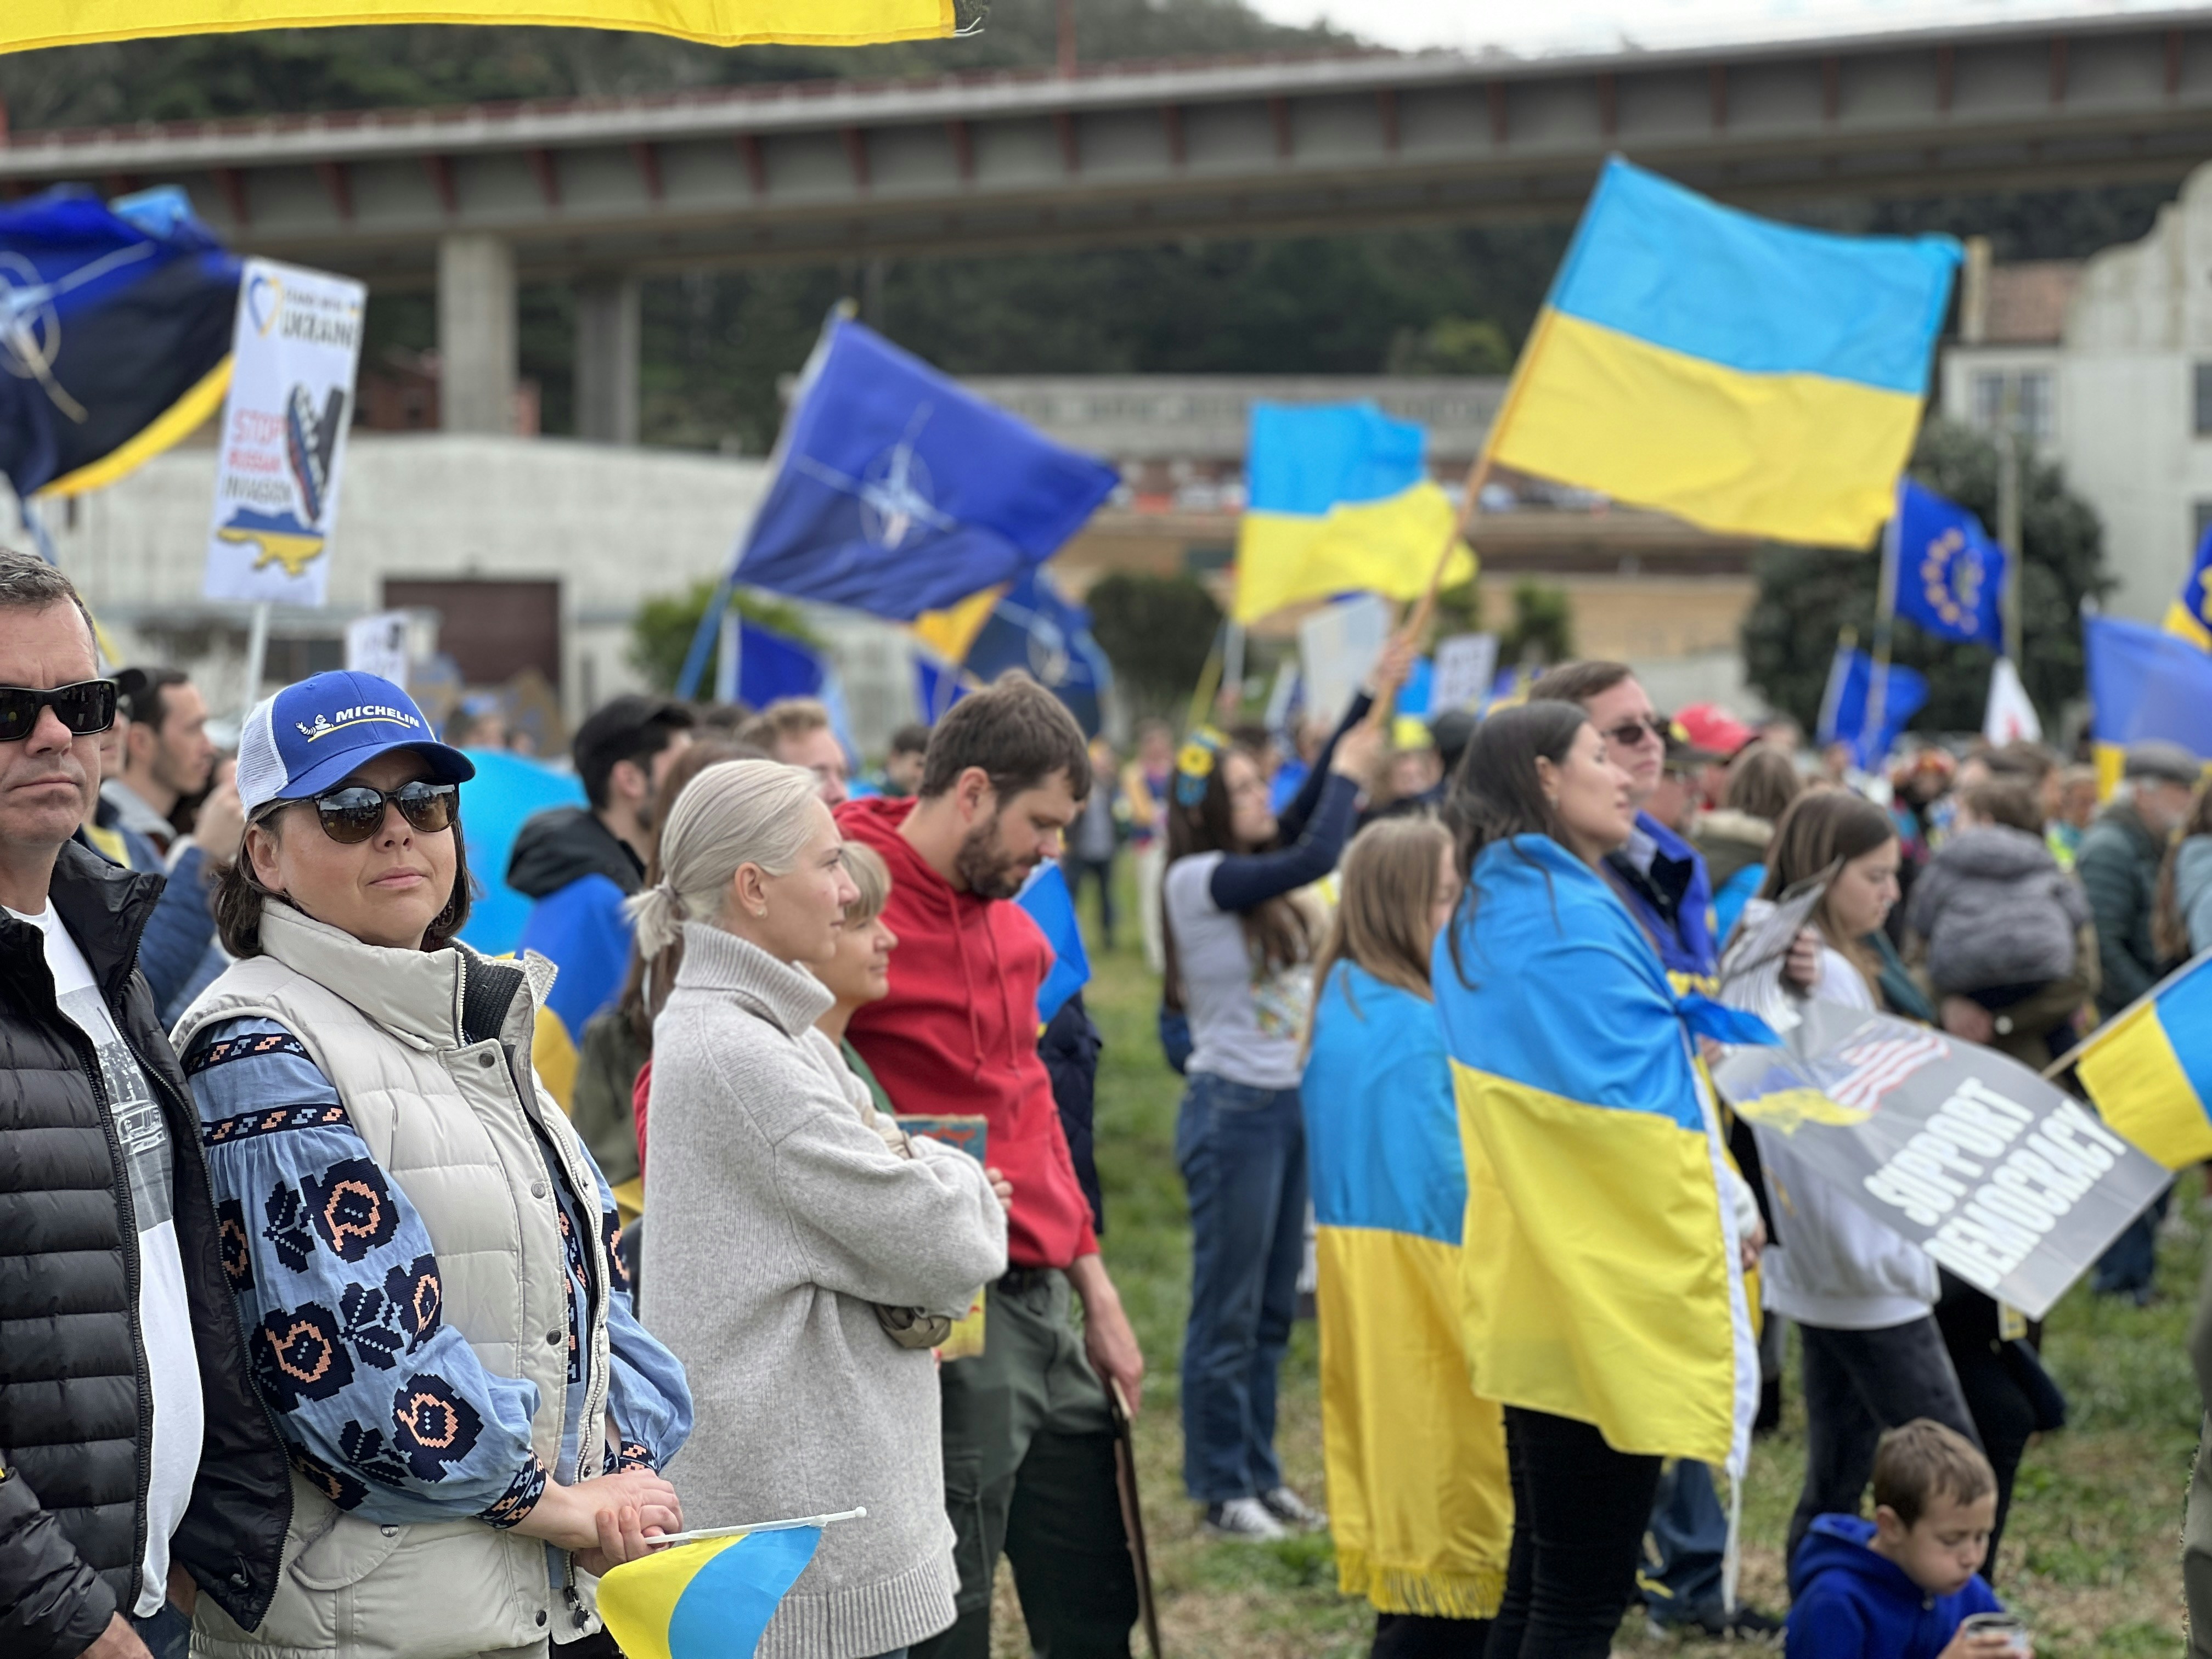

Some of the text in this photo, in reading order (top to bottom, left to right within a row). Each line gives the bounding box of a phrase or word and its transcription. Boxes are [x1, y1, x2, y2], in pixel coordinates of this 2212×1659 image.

[233, 408, 287, 445] STOP
[335, 705, 419, 728] MICHELIN
[1863, 1077, 2034, 1227] SUPPORT
